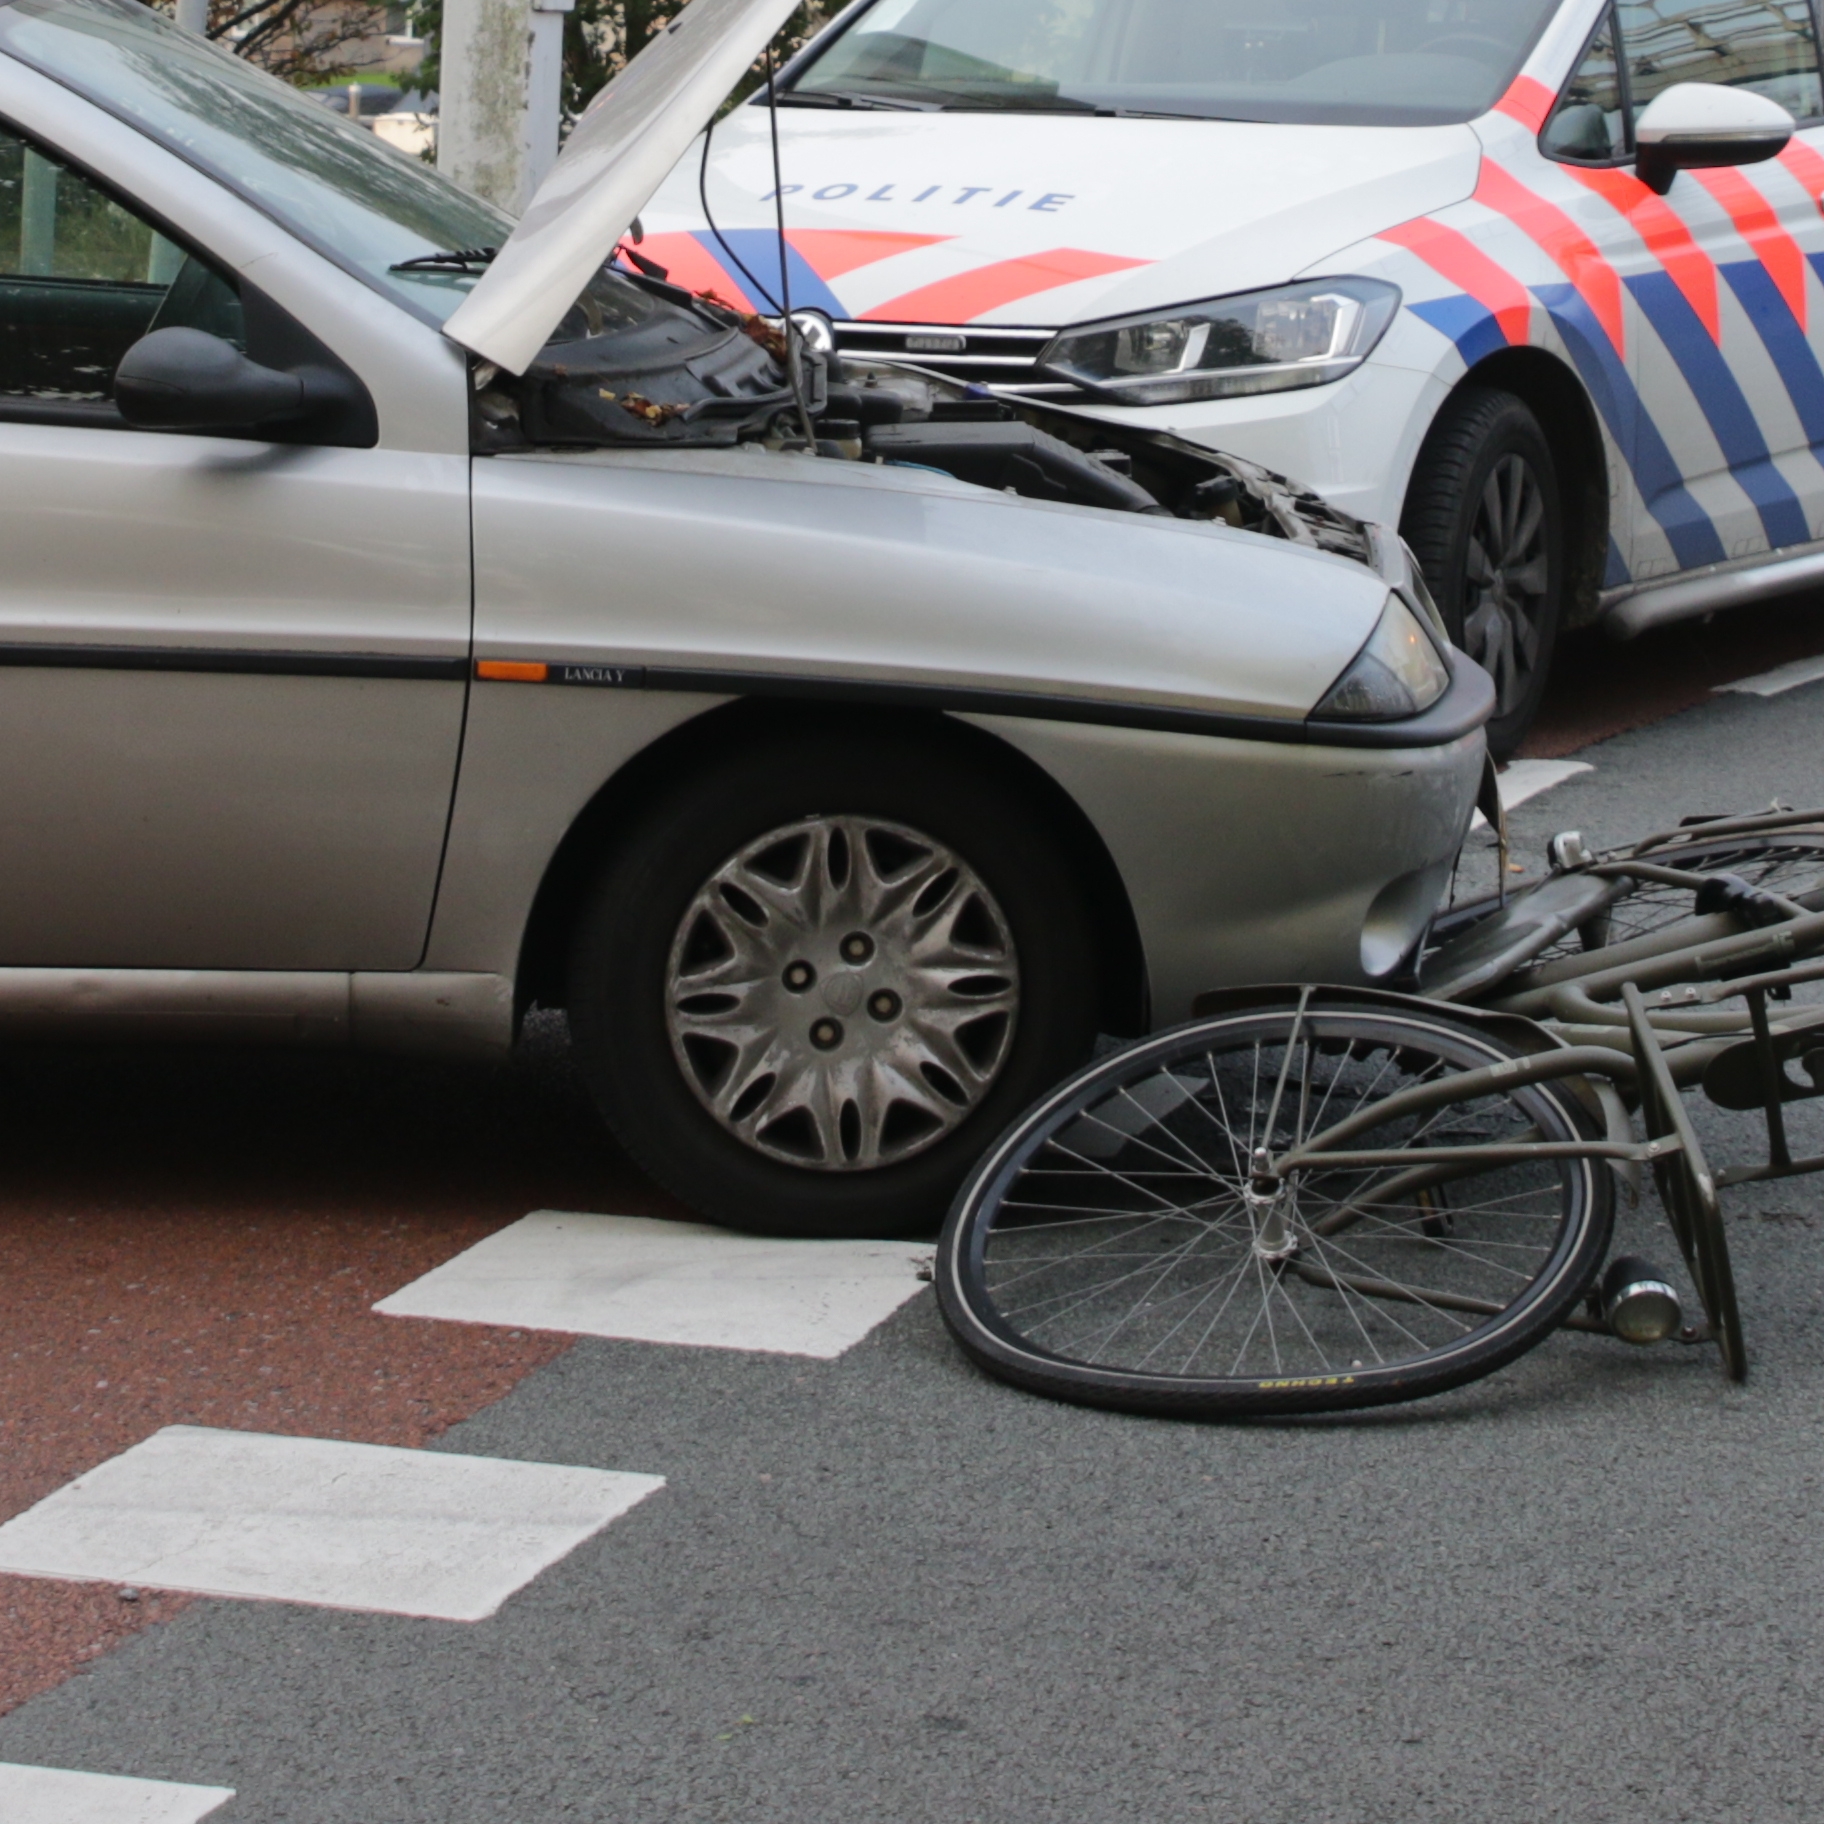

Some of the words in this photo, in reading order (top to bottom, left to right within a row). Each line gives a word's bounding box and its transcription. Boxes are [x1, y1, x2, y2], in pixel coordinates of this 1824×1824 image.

[760, 183, 1077, 213] POLITIE
[565, 666, 613, 682] LANCIA
[616, 668, 626, 682] Y
[1259, 1377, 1355, 1389] TECHNO
